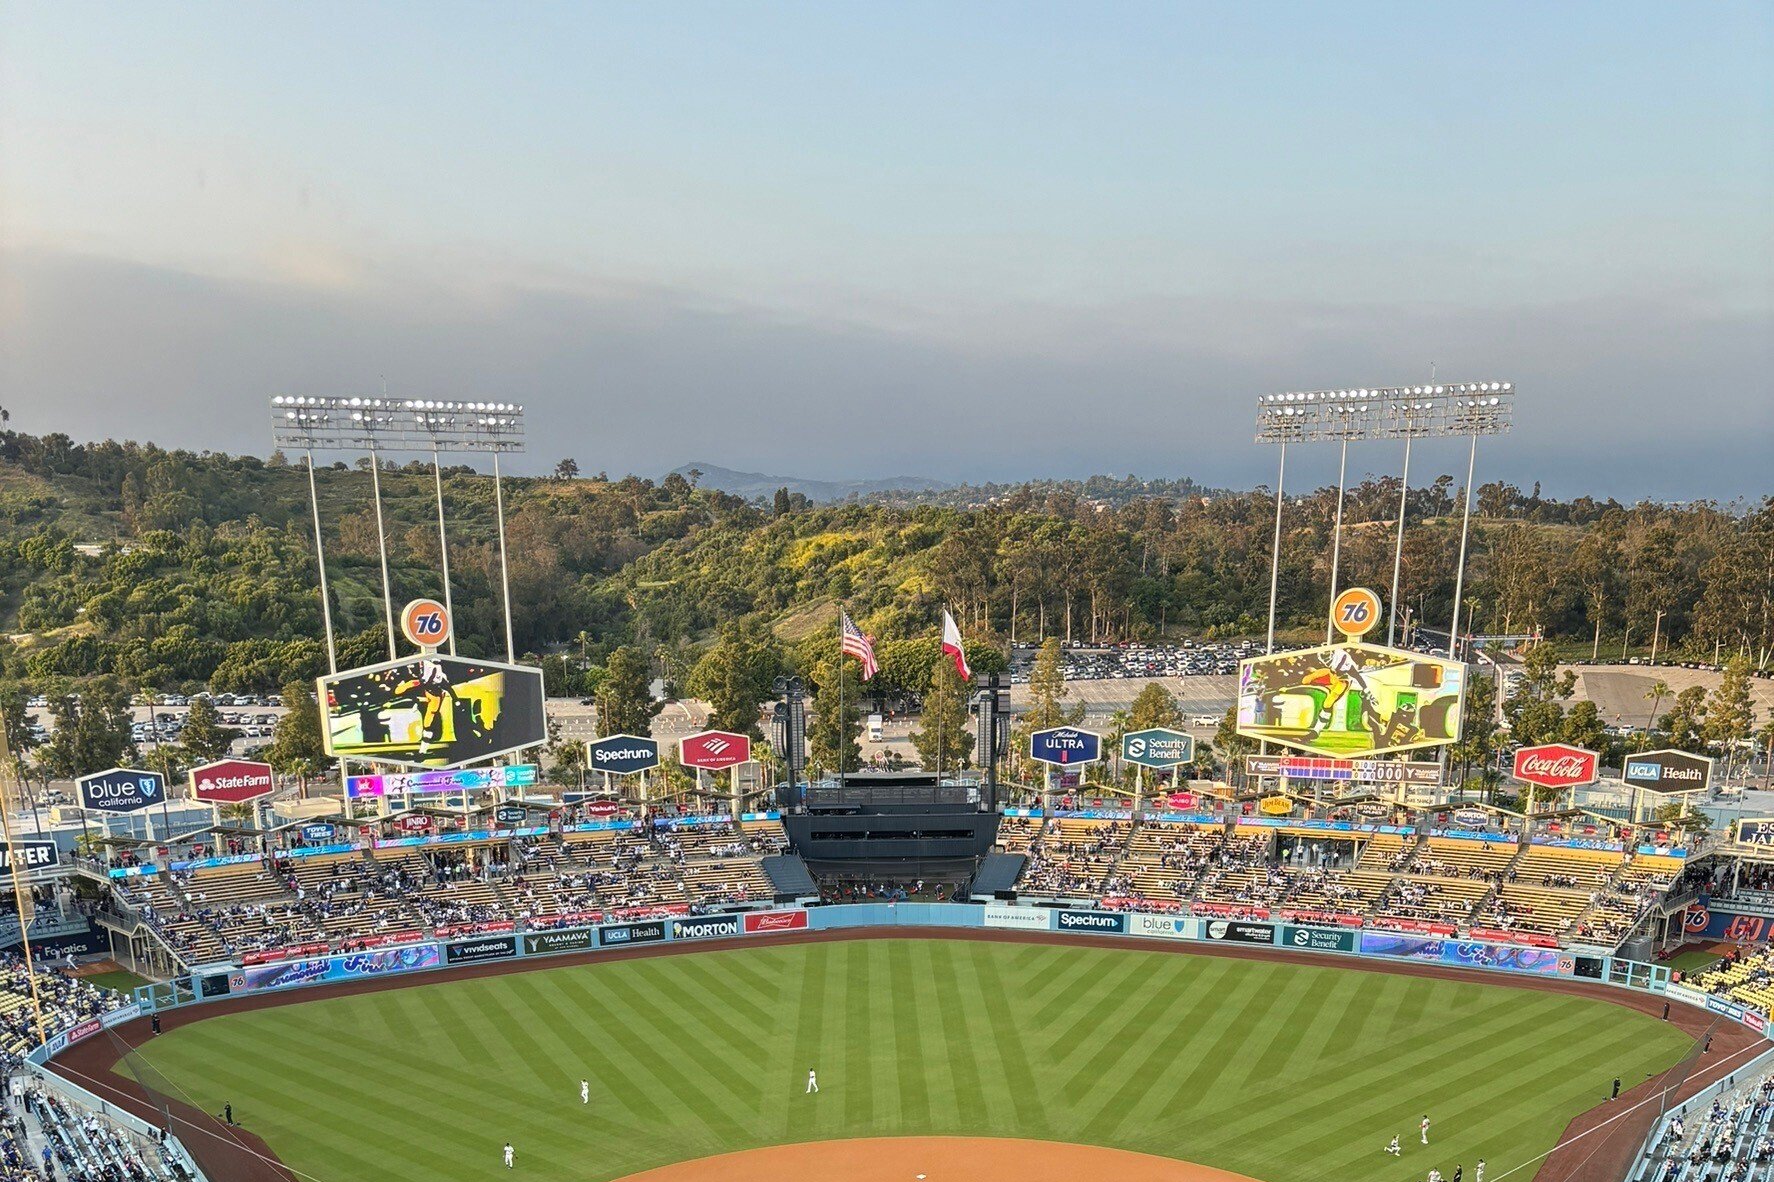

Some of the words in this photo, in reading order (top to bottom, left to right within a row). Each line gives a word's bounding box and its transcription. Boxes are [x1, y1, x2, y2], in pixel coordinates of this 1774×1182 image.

[1342, 602, 1369, 624] 76
[416, 612, 442, 634] 76
[1052, 731, 1079, 739] Michelob
[1046, 739, 1084, 749] ULTRA
[1149, 739, 1187, 750] Security
[596, 749, 650, 763] Spectrum
[1149, 749, 1183, 759] Benefit
[1521, 754, 1589, 779] Coca-Cola
[1630, 765, 1657, 778] UCLA
[1663, 767, 1702, 781] Health
[88, 780, 136, 799] blue
[98, 796, 143, 808] california
[1457, 811, 1487, 819] MORTON
[406, 817, 428, 827] JINRO
[0, 846, 50, 867] ATER
[1061, 913, 1114, 927] Spectrum
[1143, 917, 1171, 930] blue
[1685, 910, 1706, 926] 76
[632, 928, 660, 938] Health
[683, 923, 737, 937] MORTON
[1312, 931, 1342, 942] Security
[1312, 940, 1338, 950] Benefit
[1561, 960, 1572, 970] 76
[231, 977, 244, 987] 76
